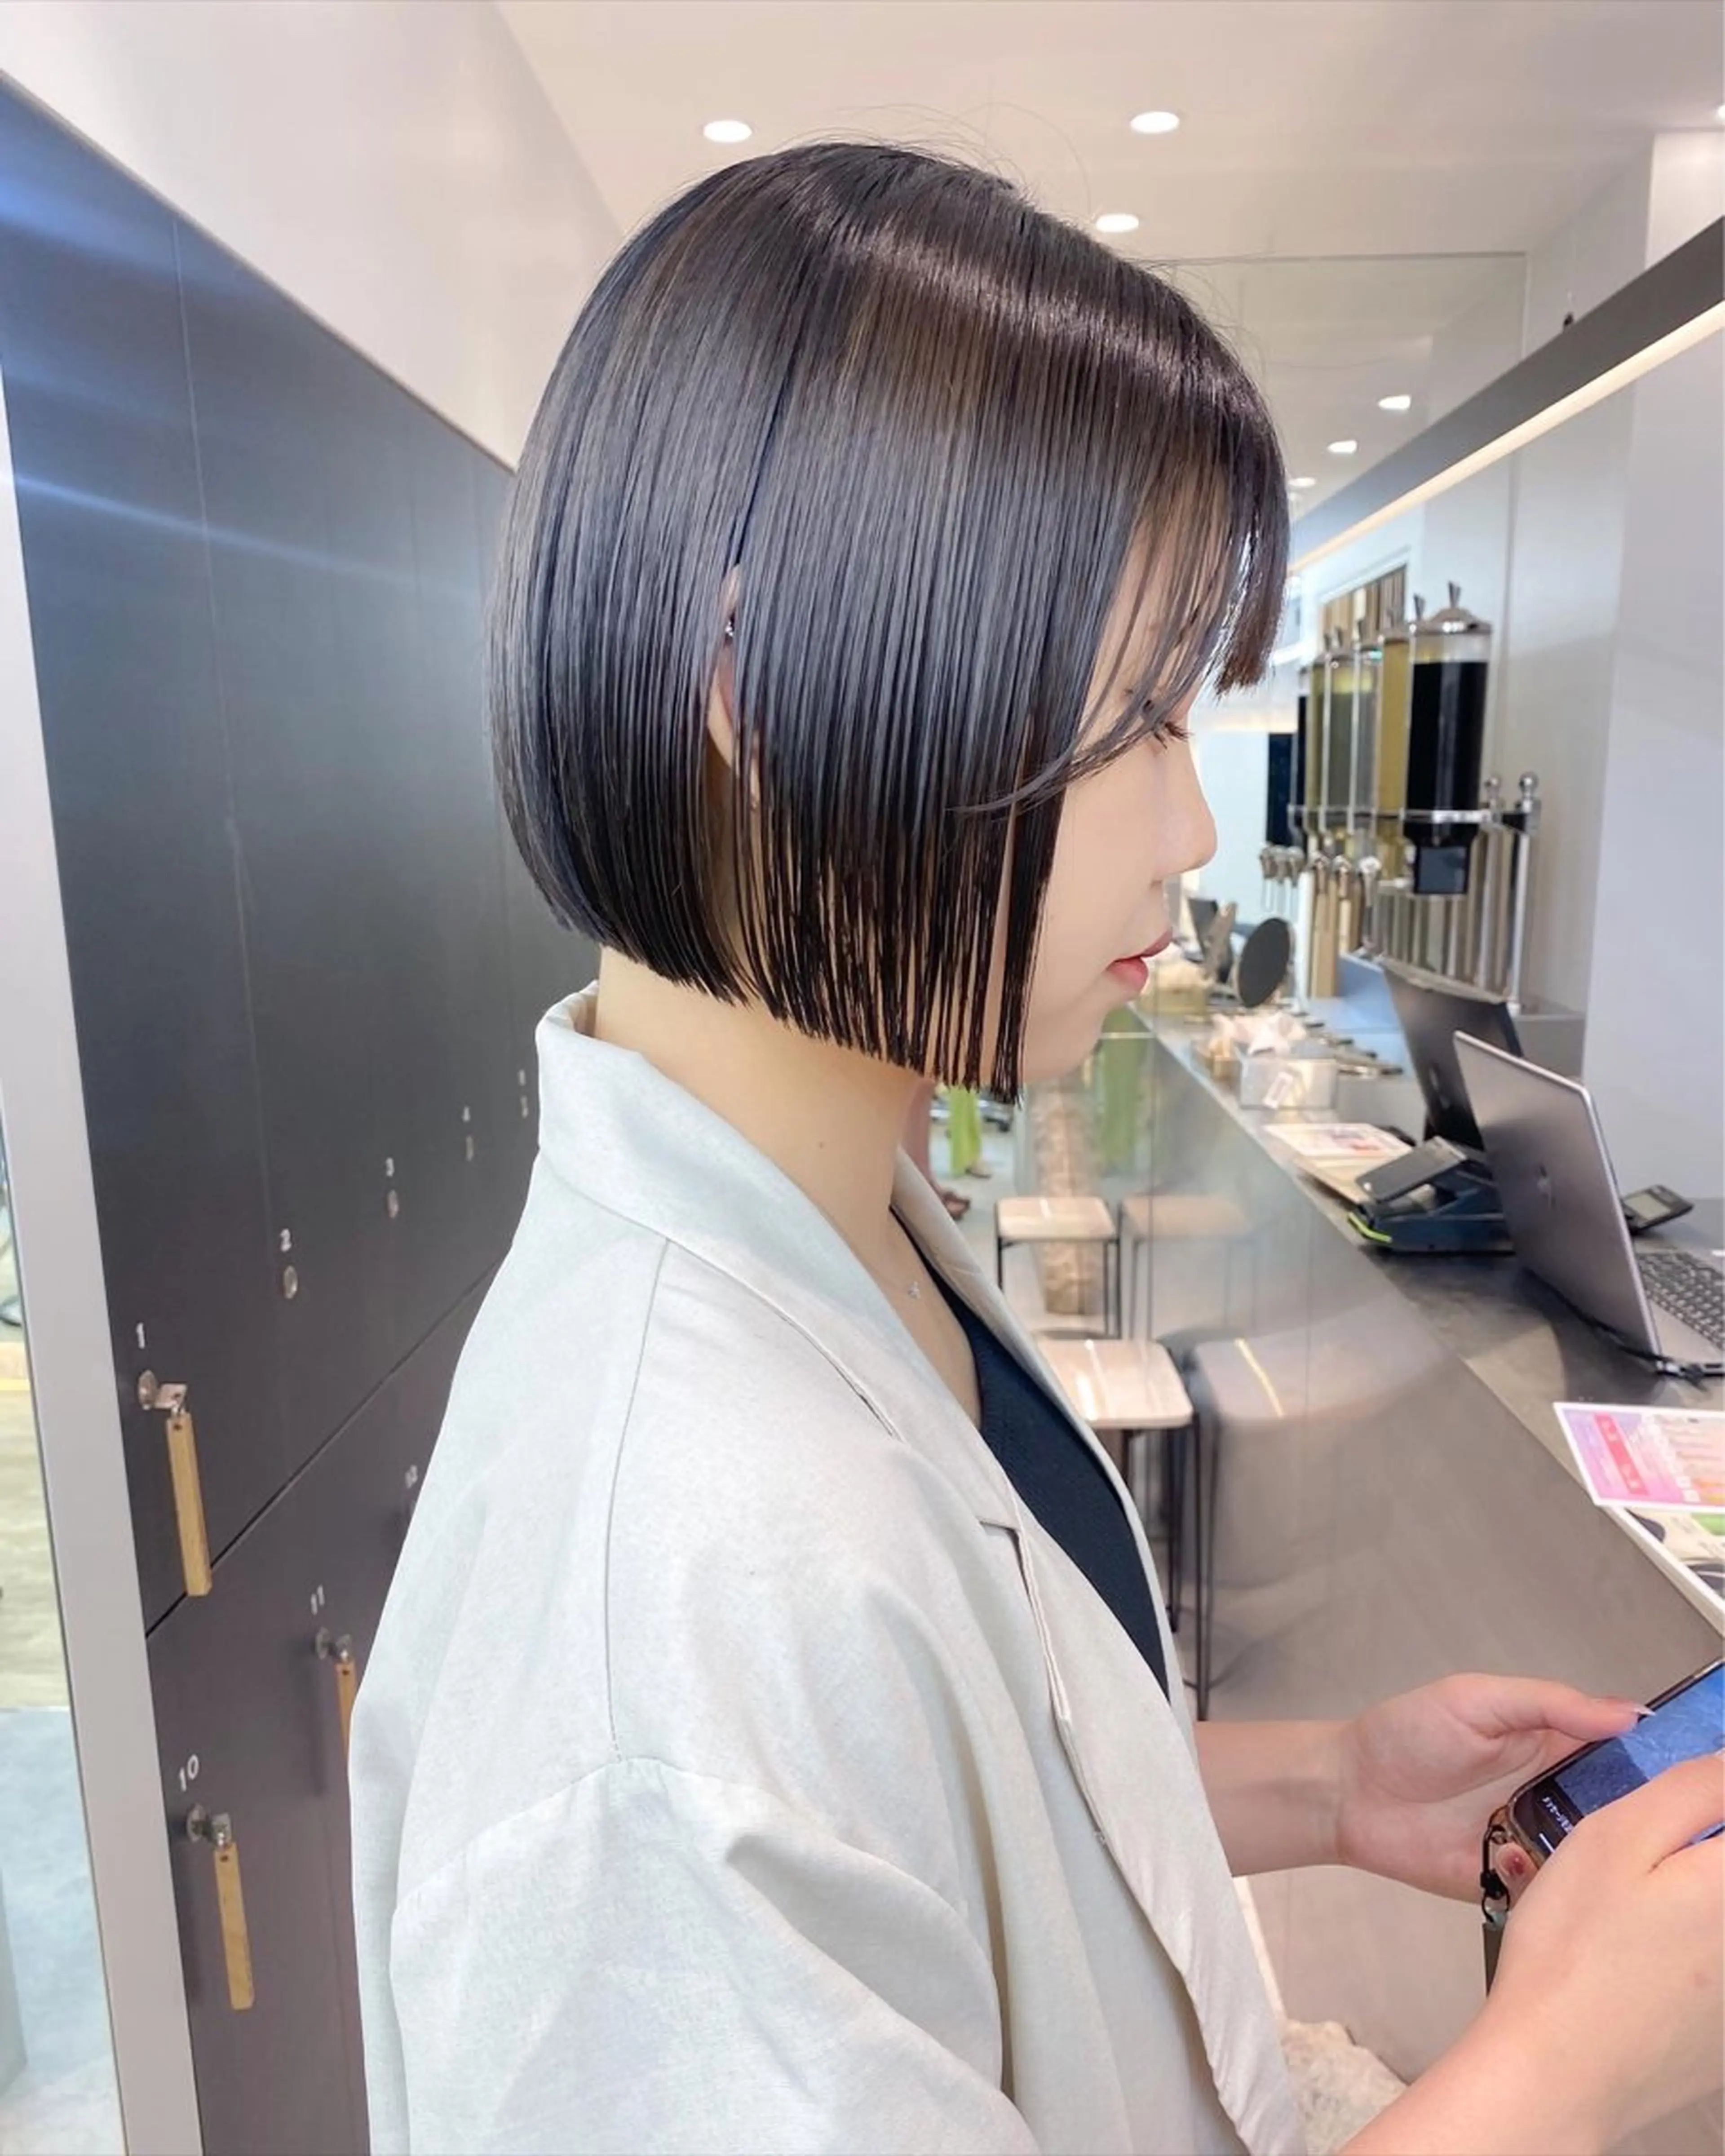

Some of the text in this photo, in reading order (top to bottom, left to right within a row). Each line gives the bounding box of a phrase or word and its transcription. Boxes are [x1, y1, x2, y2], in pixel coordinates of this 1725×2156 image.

[280, 1229, 292, 1252] 2
[136, 1323, 145, 1349] 1
[179, 1754, 199, 1792] 10
